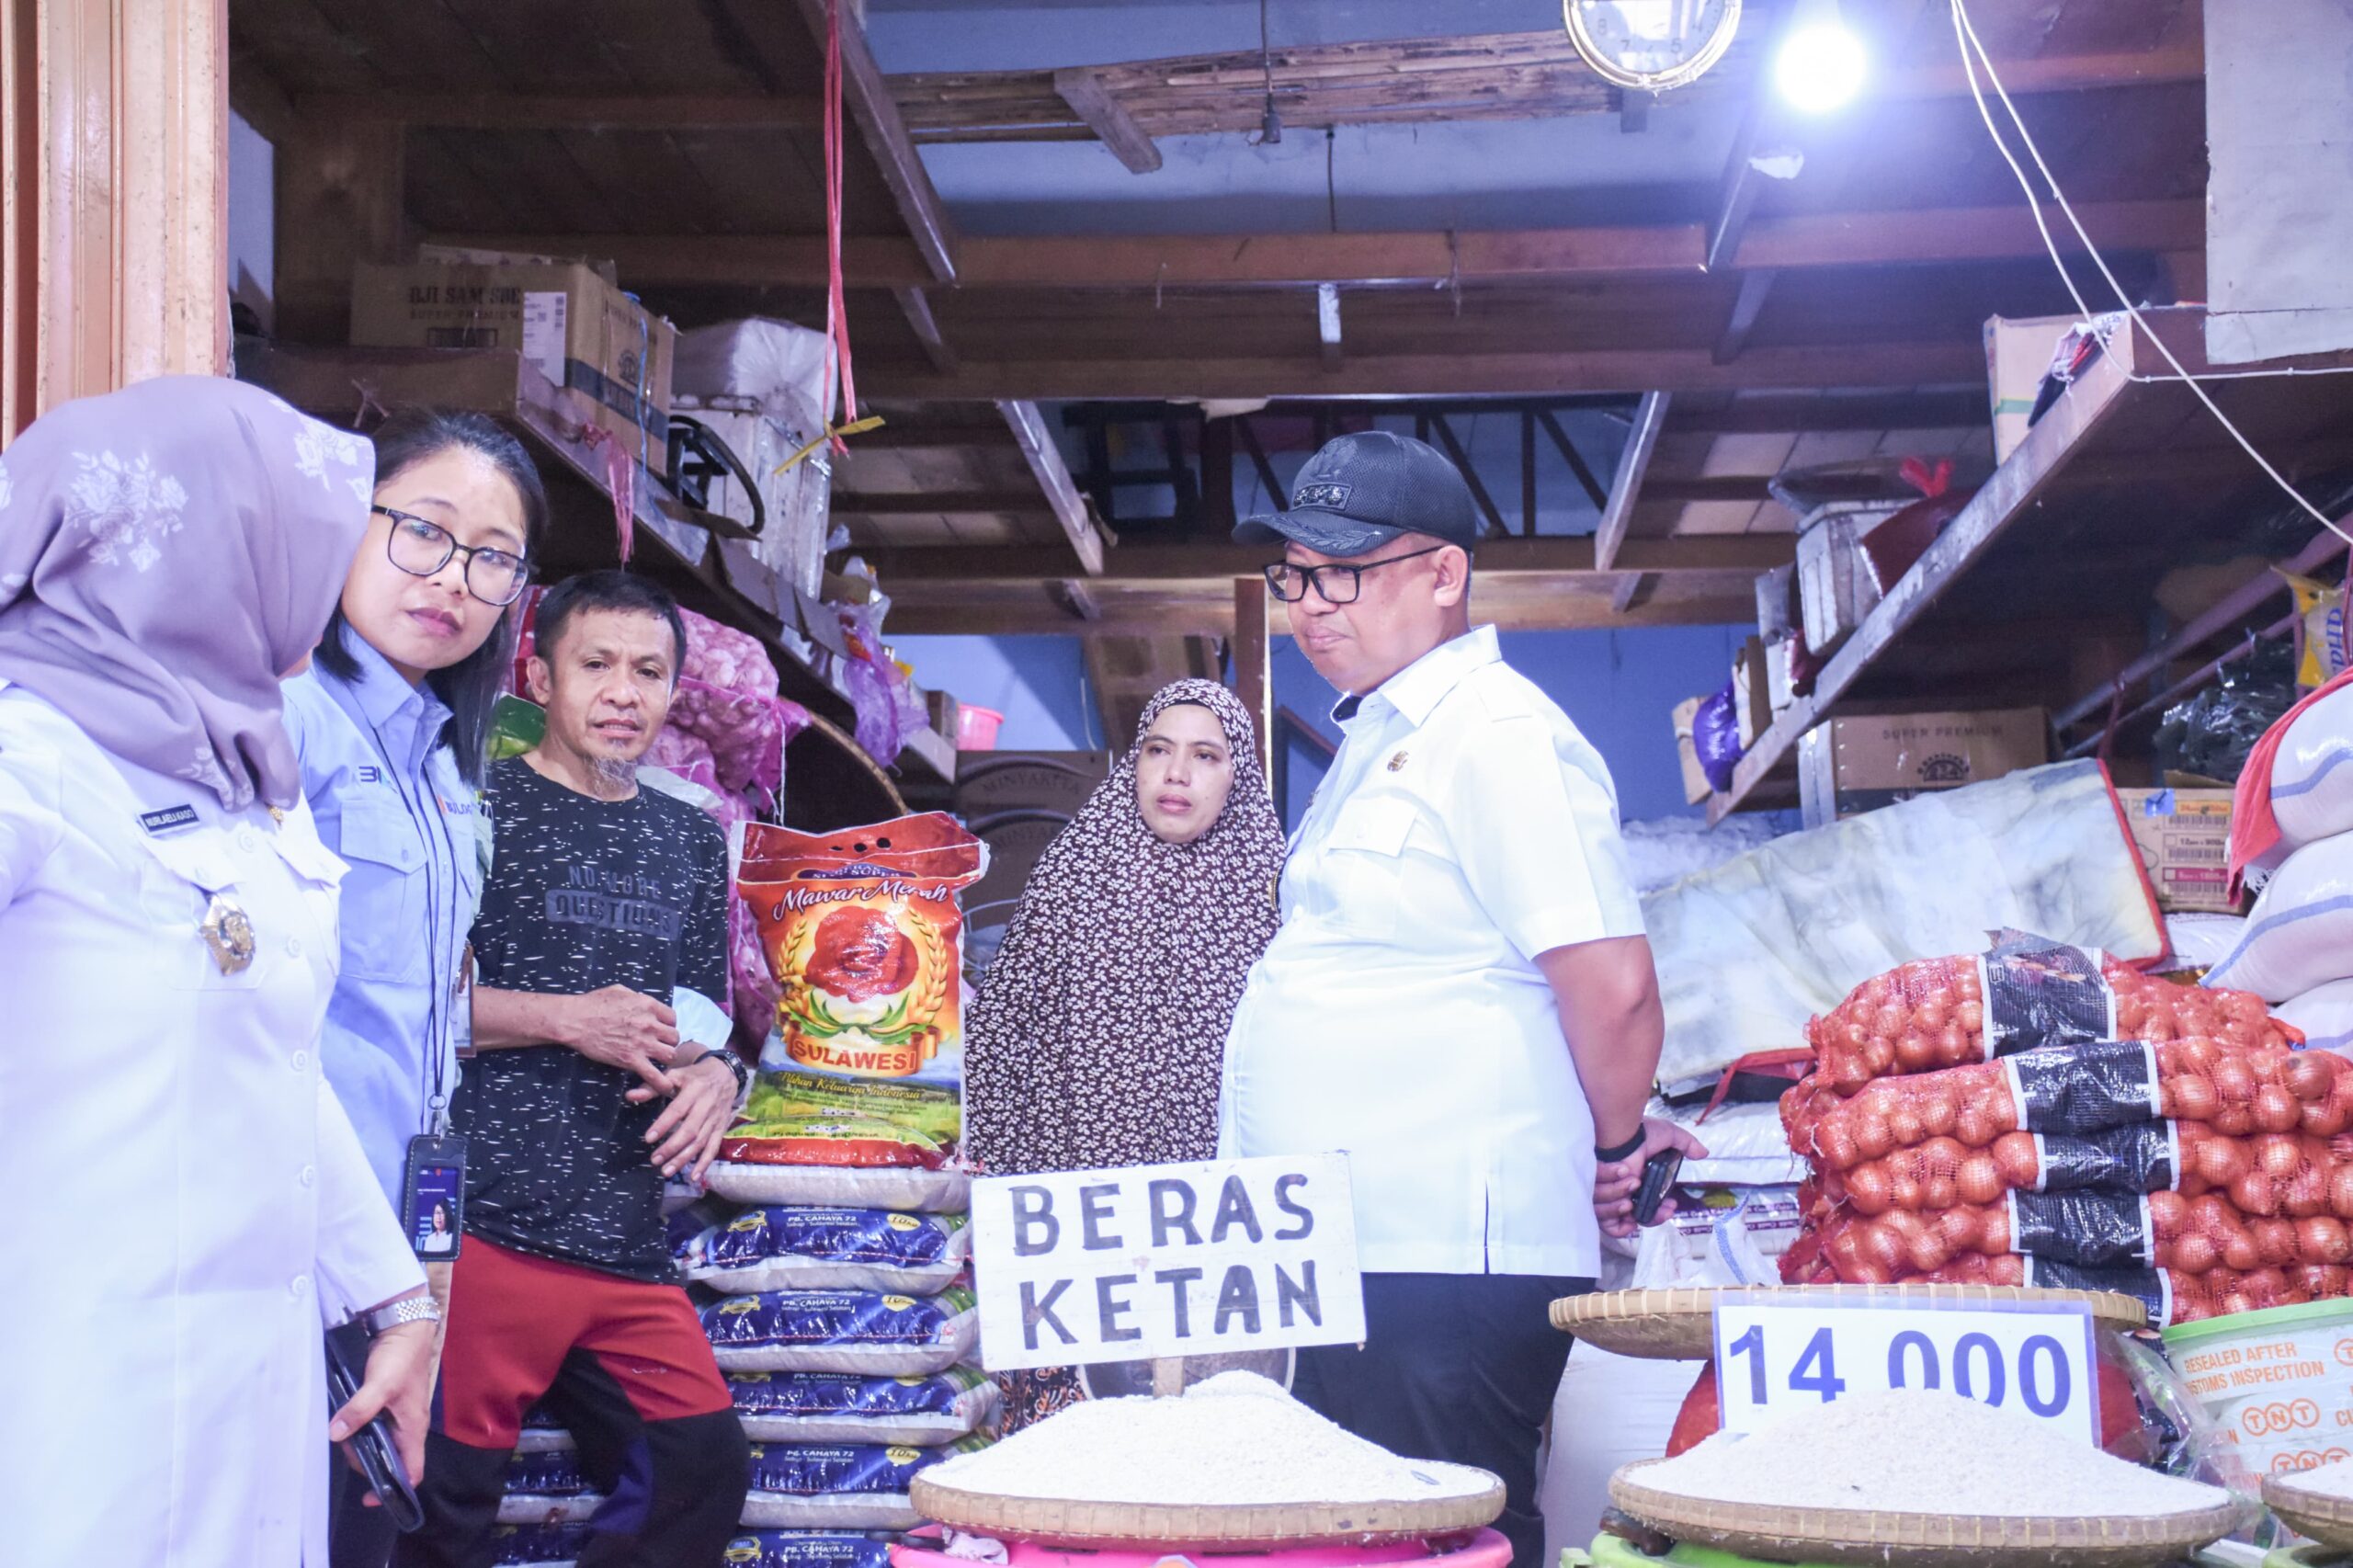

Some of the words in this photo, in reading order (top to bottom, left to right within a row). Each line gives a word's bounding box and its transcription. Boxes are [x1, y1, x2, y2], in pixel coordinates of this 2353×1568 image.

[1882, 725, 1929, 740] SUPER
[568, 865, 597, 887] NO
[603, 870, 661, 900] MORE
[555, 893, 672, 933] QUESTIONS
[772, 885, 866, 921] Mawar
[859, 880, 949, 903] Merah
[792, 1038, 917, 1071] SULAWESI
[1007, 1173, 1315, 1256] BERAS
[800, 1299, 837, 1307] CAHAYA
[1018, 1259, 1323, 1350] KETAN
[2246, 1342, 2298, 1362] AFTER
[1729, 1324, 1846, 1405] 14
[1887, 1329, 2072, 1417] 000
[2230, 1360, 2325, 1388] INSPECTION
[2243, 1398, 2321, 1437] TNT
[842, 1449, 855, 1458] 72
[801, 1545, 840, 1553] CAHAYA
[842, 1545, 855, 1553] 72
